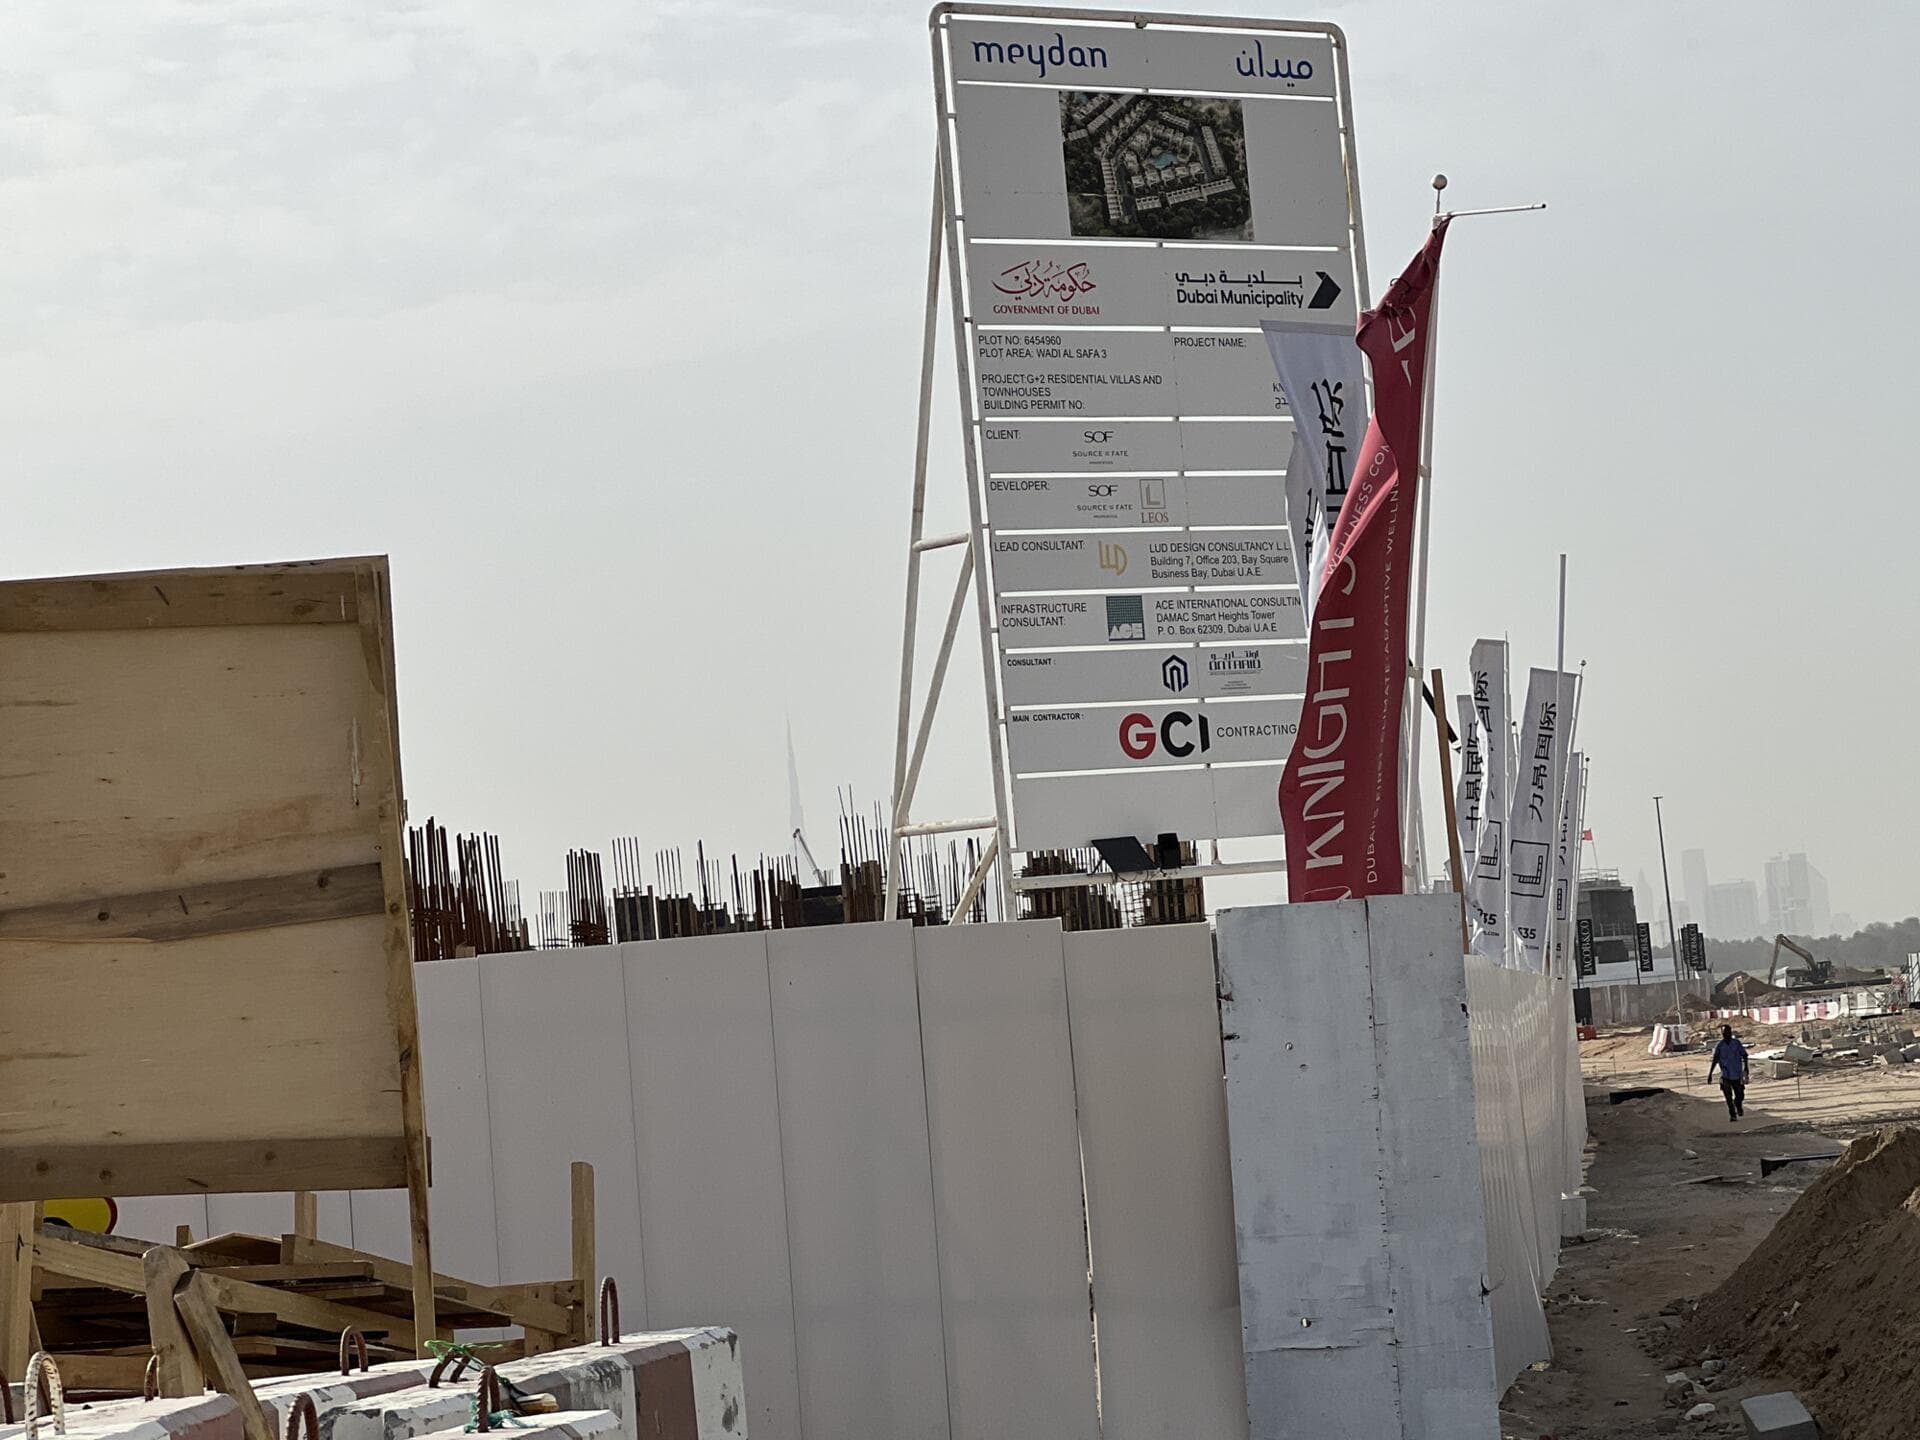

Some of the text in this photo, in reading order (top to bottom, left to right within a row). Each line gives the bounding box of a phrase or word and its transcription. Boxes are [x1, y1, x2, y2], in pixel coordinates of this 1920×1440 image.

[971, 33, 1108, 78] meydan
[1236, 39, 1313, 88] ميدان
[1175, 272, 1216, 286] دبي
[1177, 288, 1304, 309] Dubai Municipality
[993, 304, 1100, 315] GOVERNMENT OF DUBAI
[978, 335, 1062, 346] PLOT NO: 6454960
[1174, 337, 1247, 348] PROJECT NAME:
[979, 348, 1108, 359] PLOT AREA: WADI AL SAFA 3
[1047, 374, 1108, 384] RESIDENTIAL
[1109, 374, 1141, 385] VILLAS
[1143, 375, 1163, 385] AND
[983, 387, 1051, 397] TOWNHOUSES
[984, 400, 1028, 410] BUILDING
[1030, 400, 1066, 410] PERMIT
[986, 430, 1021, 440] CLIENT:
[1084, 431, 1115, 443] SOF
[1072, 450, 1103, 458] SOURCE
[990, 481, 1050, 491] DEVELOPER:
[1088, 485, 1119, 497] SOF
[1076, 504, 1107, 512] SOURCE
[1141, 512, 1169, 524] LEOS
[994, 540, 1086, 552] LEAD CONSULTANT:
[1150, 543, 1168, 553] LUD
[1170, 542, 1206, 552] DESIGN
[1208, 541, 1274, 551] CONSULTANCY
[1151, 554, 1289, 567] Building 7, Office 203, Bay Square
[1152, 569, 1189, 579] Business
[1191, 569, 1210, 580] Bay,
[1212, 567, 1235, 577] Dubai
[1001, 602, 1087, 614] INFRASTRUCTURE
[1155, 597, 1301, 610] ACE INTERNATIONAL CONSULTIN
[1002, 616, 1066, 627] CONSULTANT:
[1156, 610, 1275, 623] DAMAC Smart Heights Tower
[1179, 625, 1195, 635] Box
[1228, 622, 1251, 634] Dubai
[1012, 714, 1030, 722] MAIN
[1216, 724, 1298, 738] CONTRACTING
[1529, 701, 1557, 822] 力昂国际
[1580, 920, 1593, 974] JACOB&CO
